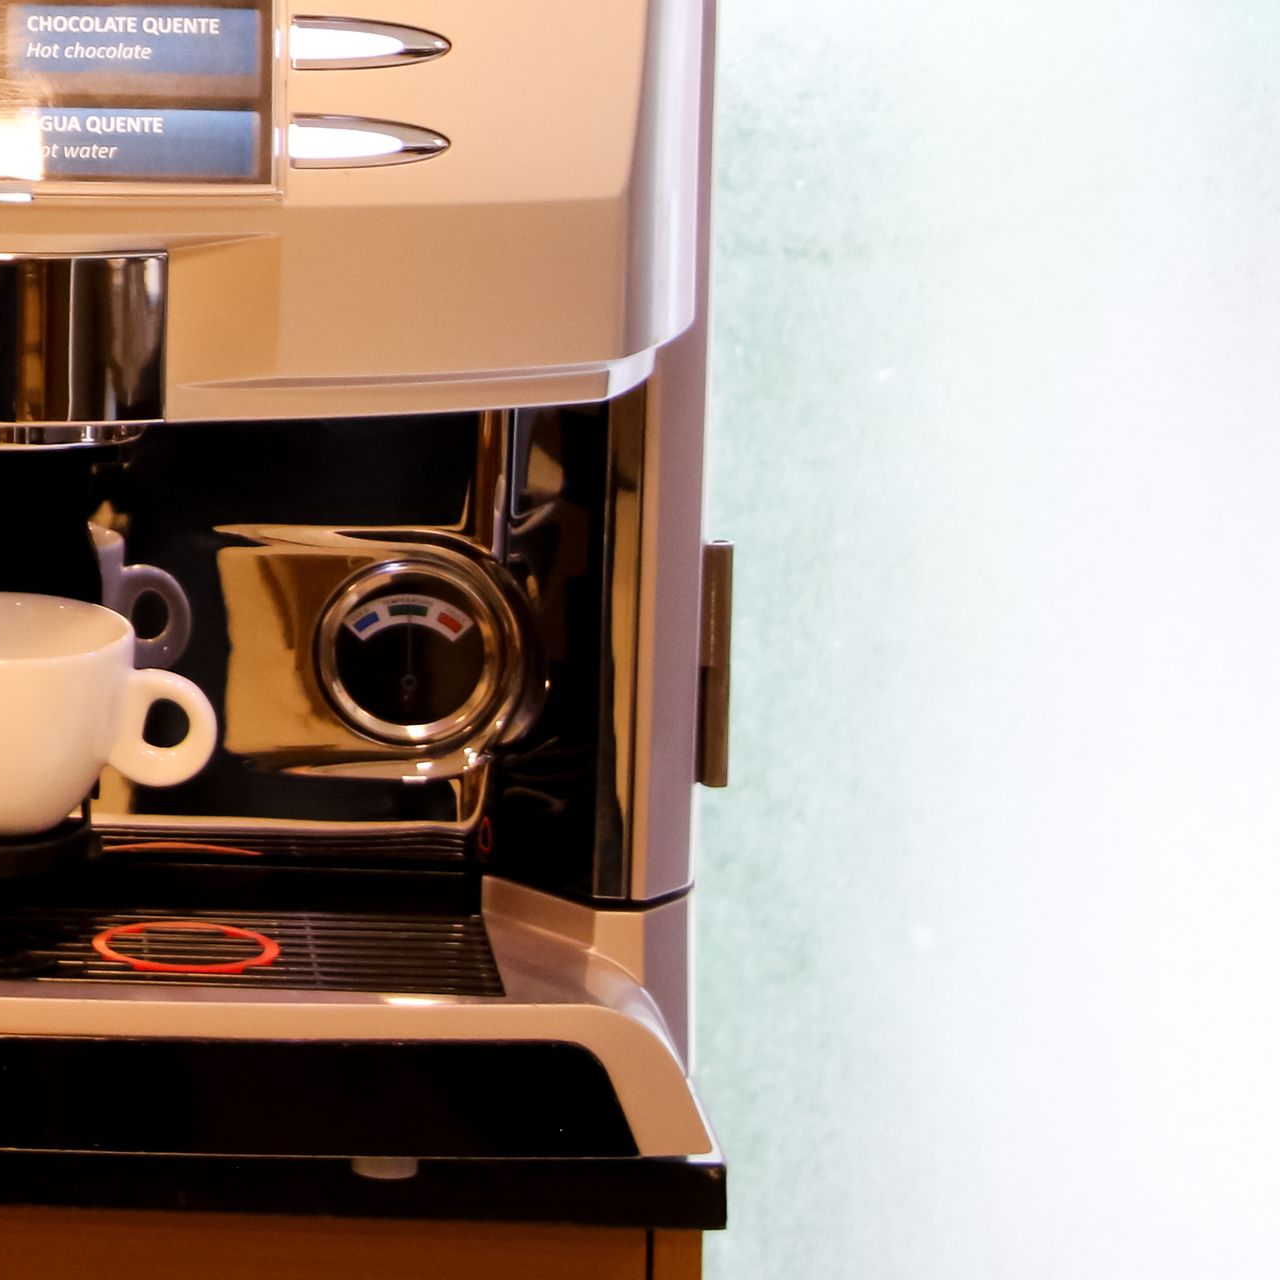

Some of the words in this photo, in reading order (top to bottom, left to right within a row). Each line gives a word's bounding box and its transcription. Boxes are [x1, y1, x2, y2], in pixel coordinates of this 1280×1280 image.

[27, 14, 137, 34] CHOCOLATE
[142, 16, 220, 37] QUENTE
[26, 41, 59, 59] Hot
[62, 41, 152, 61] chocolate
[40, 116, 81, 132] GUA
[86, 116, 164, 134] QUENTE
[41, 143, 58, 158] ot
[64, 145, 117, 159] water
